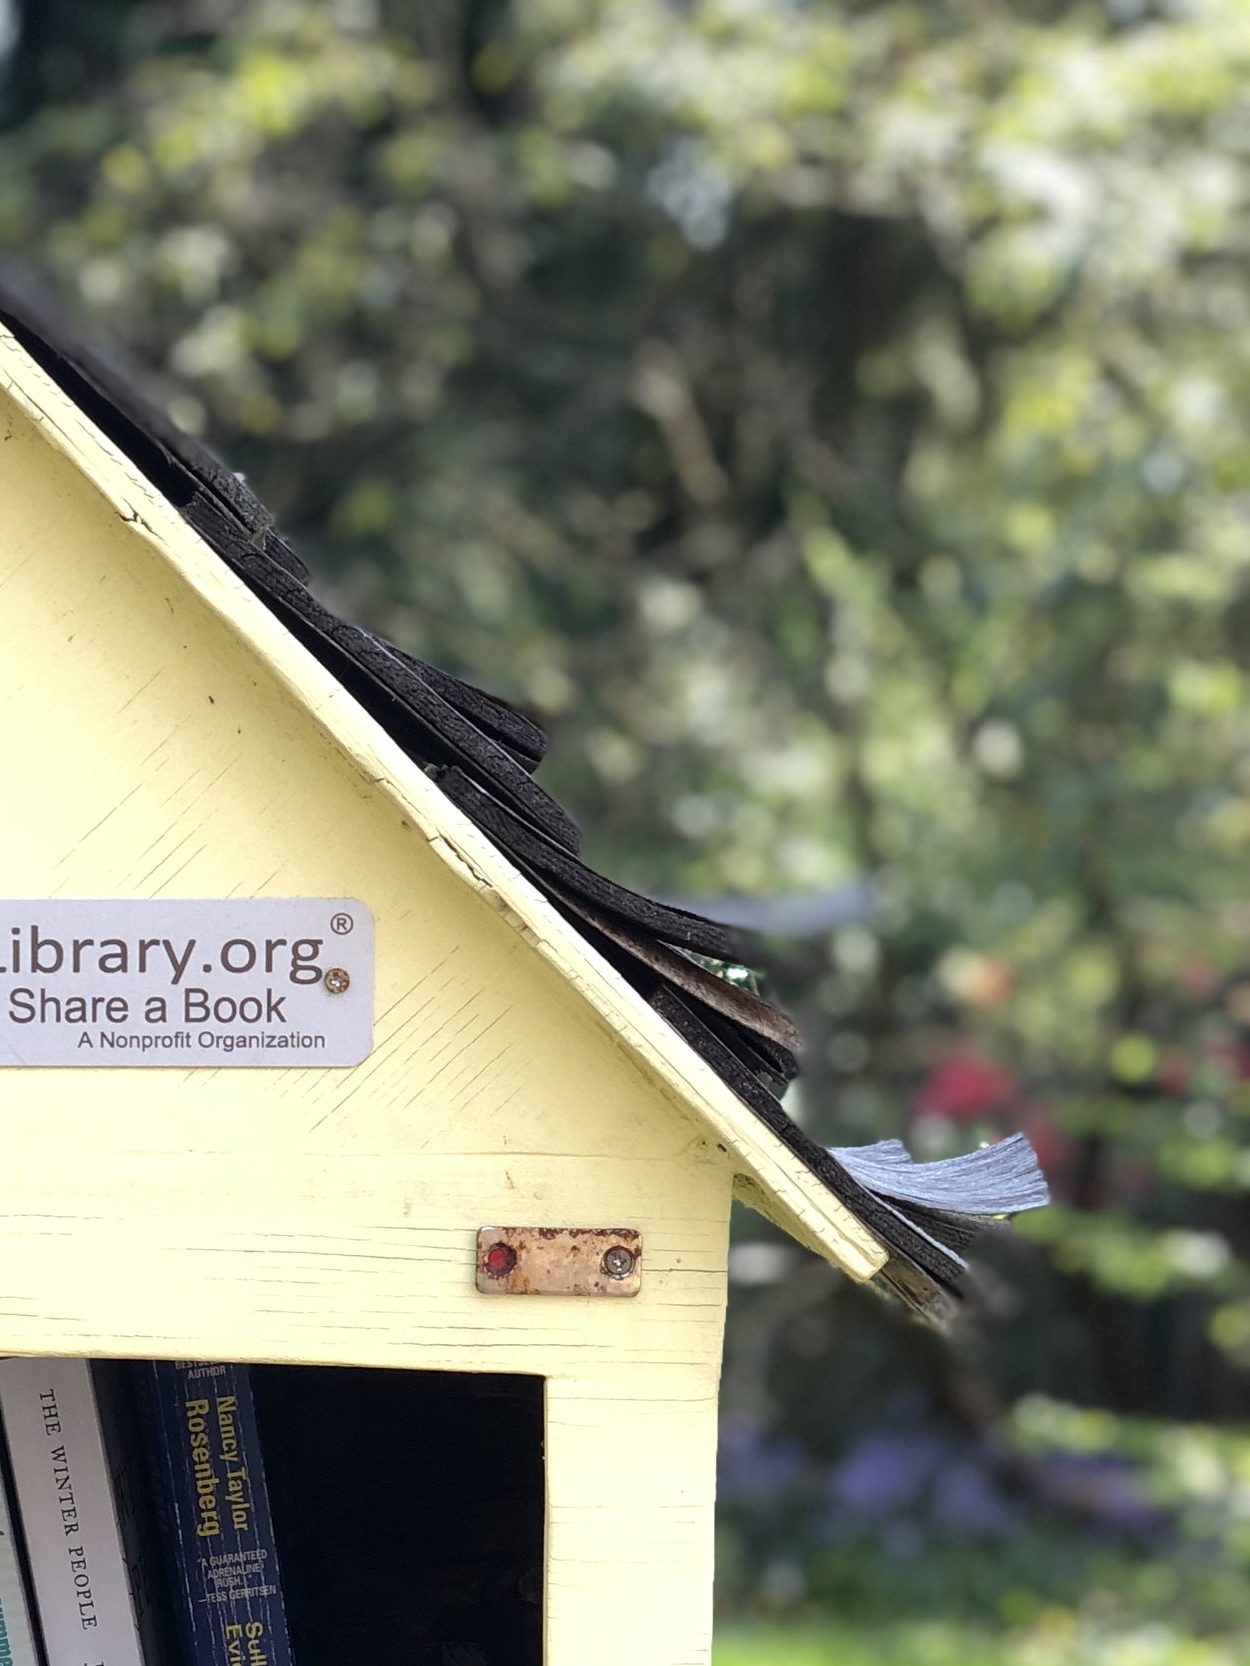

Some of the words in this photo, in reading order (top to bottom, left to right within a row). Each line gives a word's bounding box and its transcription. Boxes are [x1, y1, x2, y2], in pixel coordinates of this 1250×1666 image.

[8, 989, 132, 1025] Share
[143, 998, 168, 1025] a
[183, 987, 287, 1025] Book
[77, 1032, 96, 1050] A
[99, 1031, 194, 1051] Nonprofit
[198, 1029, 326, 1055] Organization
[39, 1388, 62, 1437] THE
[216, 1395, 239, 1462] Nancy
[50, 1445, 80, 1537] WINTER
[185, 1398, 222, 1538] Rosenberg
[225, 1466, 251, 1532] Taylor
[68, 1546, 98, 1631] PEOPLE
